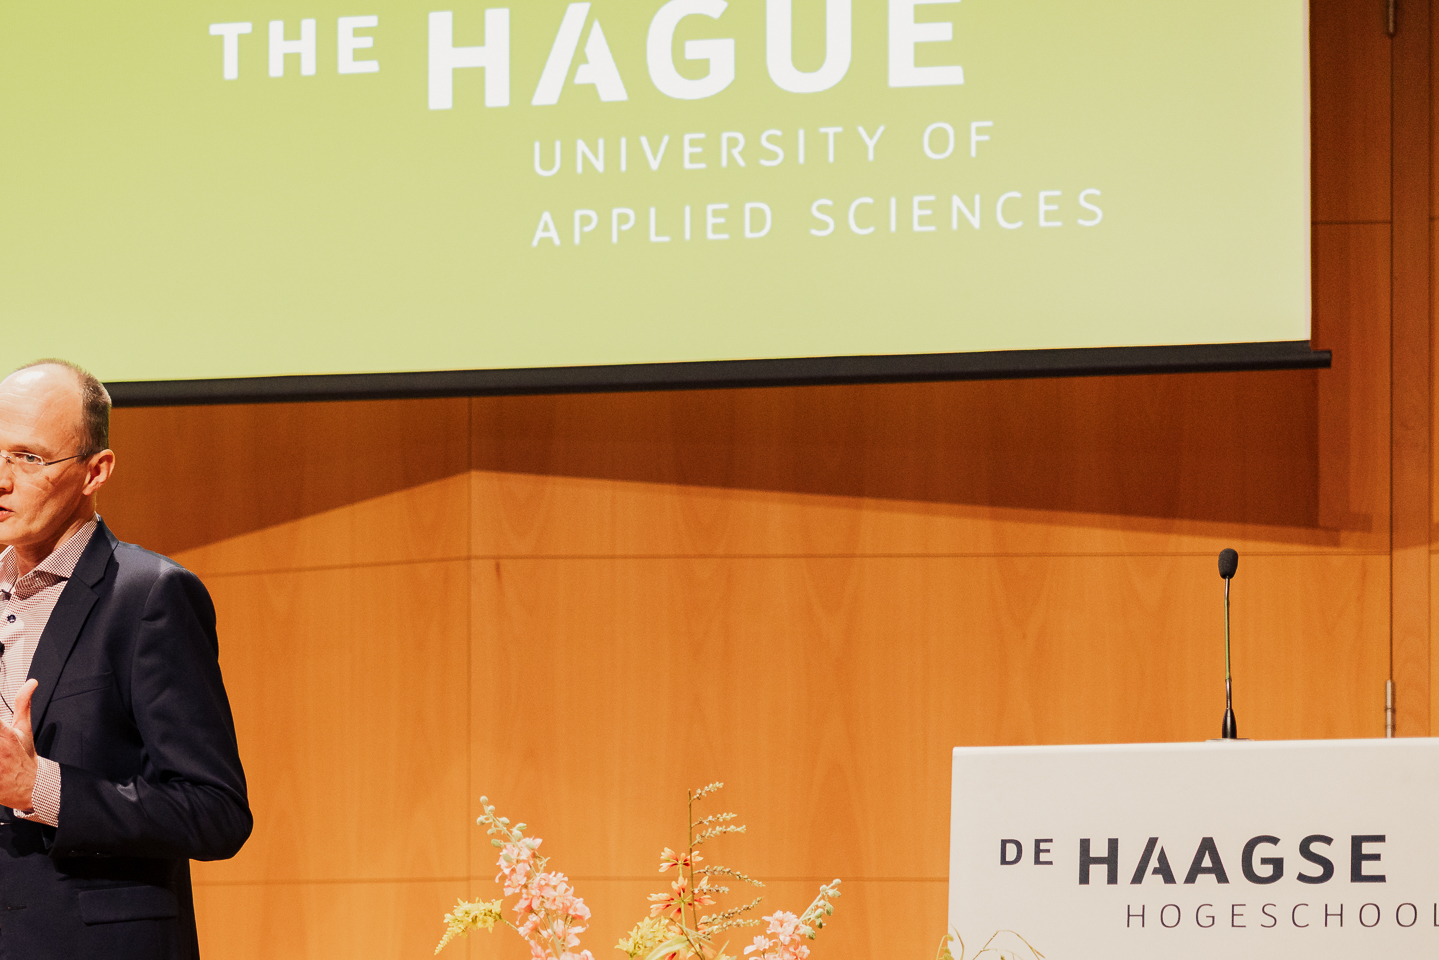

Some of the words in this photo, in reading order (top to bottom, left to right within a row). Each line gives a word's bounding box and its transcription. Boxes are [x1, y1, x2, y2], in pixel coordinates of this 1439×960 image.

[209, 15, 380, 80] THE
[427, 0, 965, 110] HAGUE
[534, 125, 886, 177] UNIVERSITY
[923, 121, 994, 160] OF
[532, 202, 773, 247] APPLIED
[810, 188, 1104, 237] SCIENCES
[1000, 838, 1054, 866] DE
[1078, 834, 1387, 886] HAAGSE
